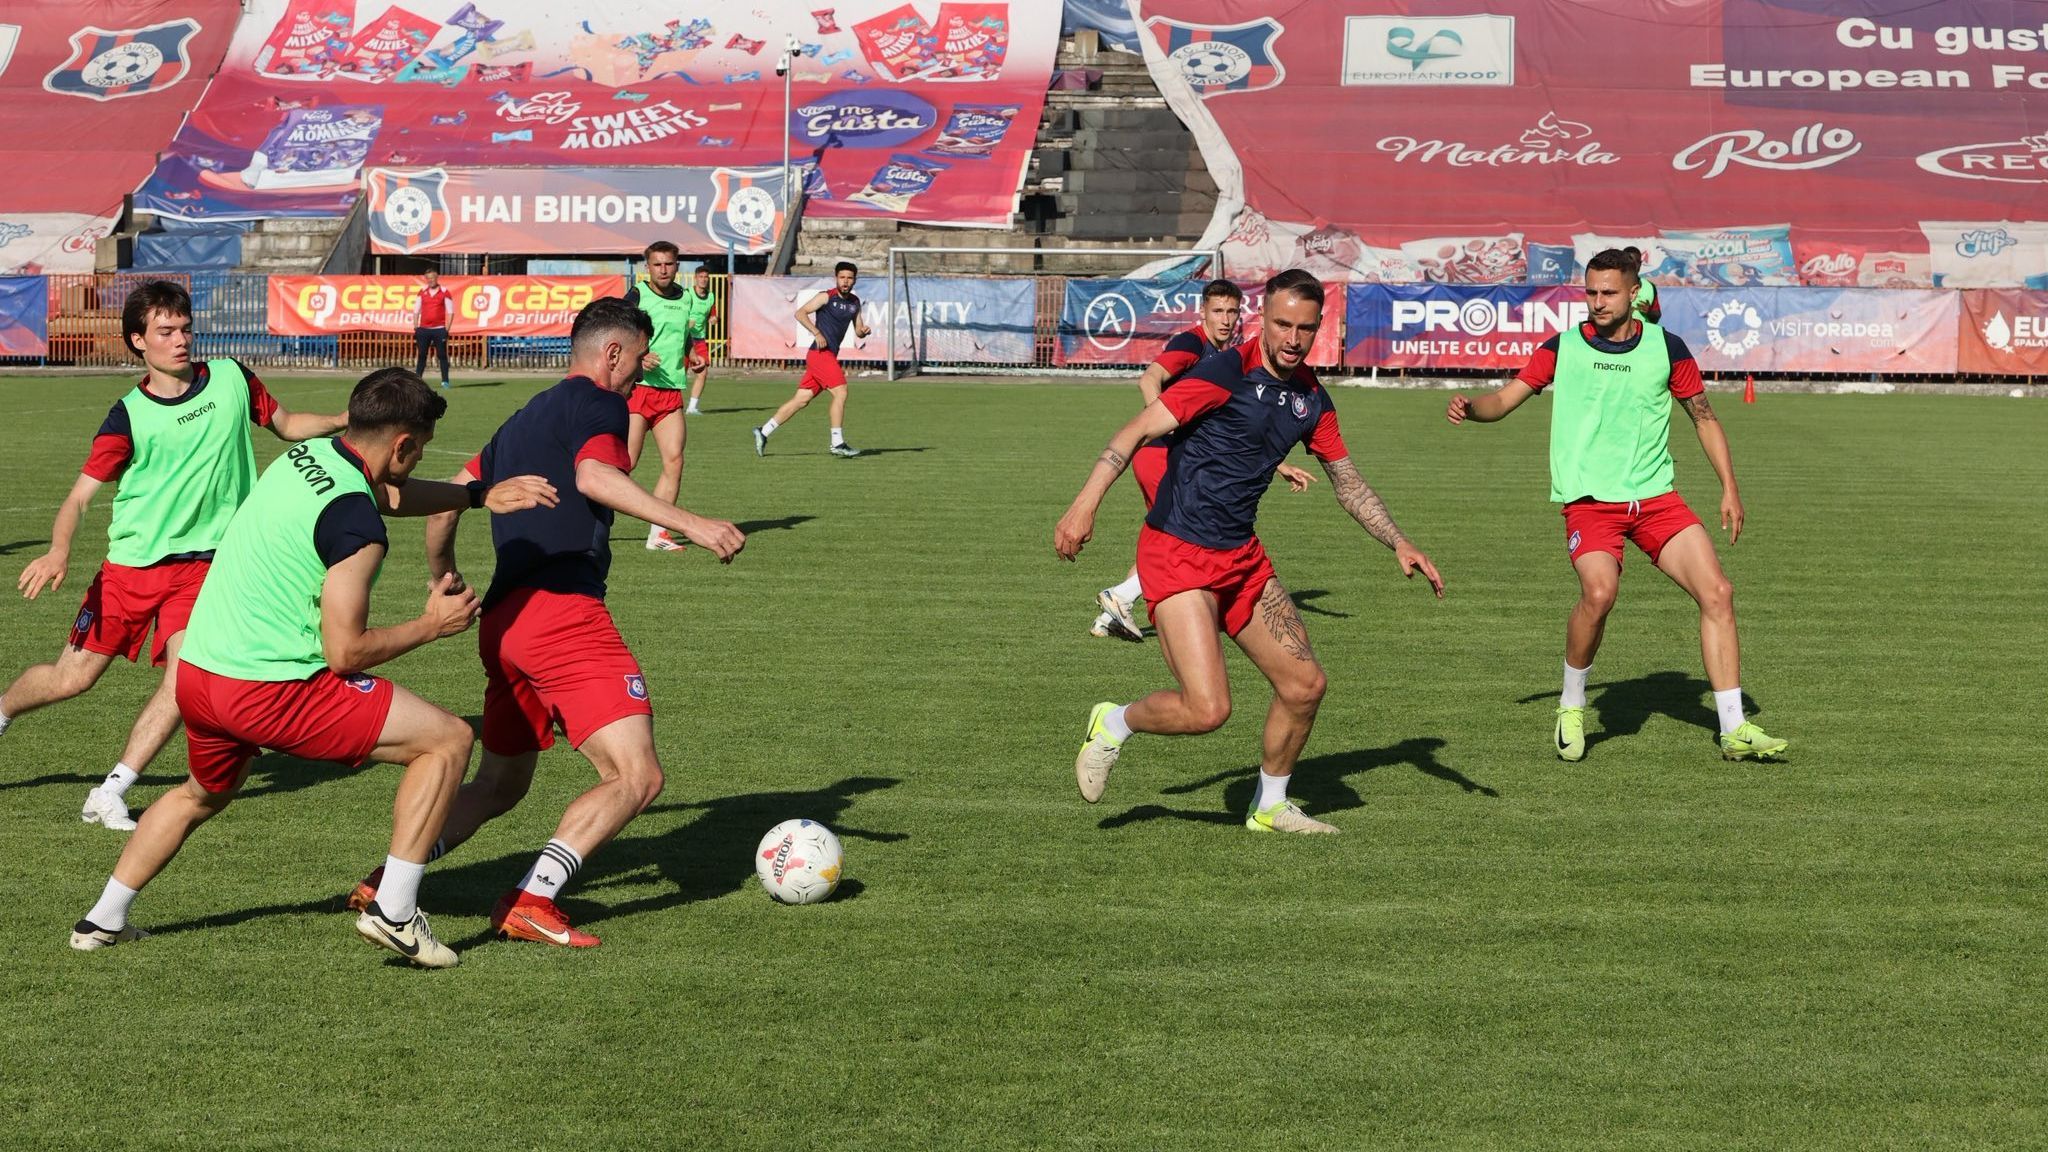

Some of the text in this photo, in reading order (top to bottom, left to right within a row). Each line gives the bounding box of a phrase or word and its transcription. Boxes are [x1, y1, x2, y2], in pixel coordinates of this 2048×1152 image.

[1836, 17, 1913, 49] Cu
[1203, 42, 1246, 61] BIHOR
[1184, 72, 1239, 86] RADEA
[1690, 64, 1971, 91] European
[496, 98, 582, 124] Naty
[567, 100, 683, 132] SWEET
[807, 110, 928, 137] Gusta
[840, 106, 874, 116] me
[958, 117, 1006, 128] Gusta
[559, 109, 709, 149] MOMENTS
[1672, 122, 1862, 180] Rollo
[461, 195, 521, 223] HAI
[1695, 240, 1746, 259] COCOA
[1801, 252, 1857, 277] Rollo
[505, 285, 594, 311] casa
[1150, 292, 1265, 315] ASTRI
[339, 310, 422, 326] pariurilo
[866, 300, 973, 325] MARTY
[1392, 298, 1589, 336] PROLINE
[1391, 340, 1545, 356] UNELTE CU CAR
[1593, 362, 1631, 372] macron
[1278, 391, 1287, 405] 5
[177, 401, 216, 426] macron
